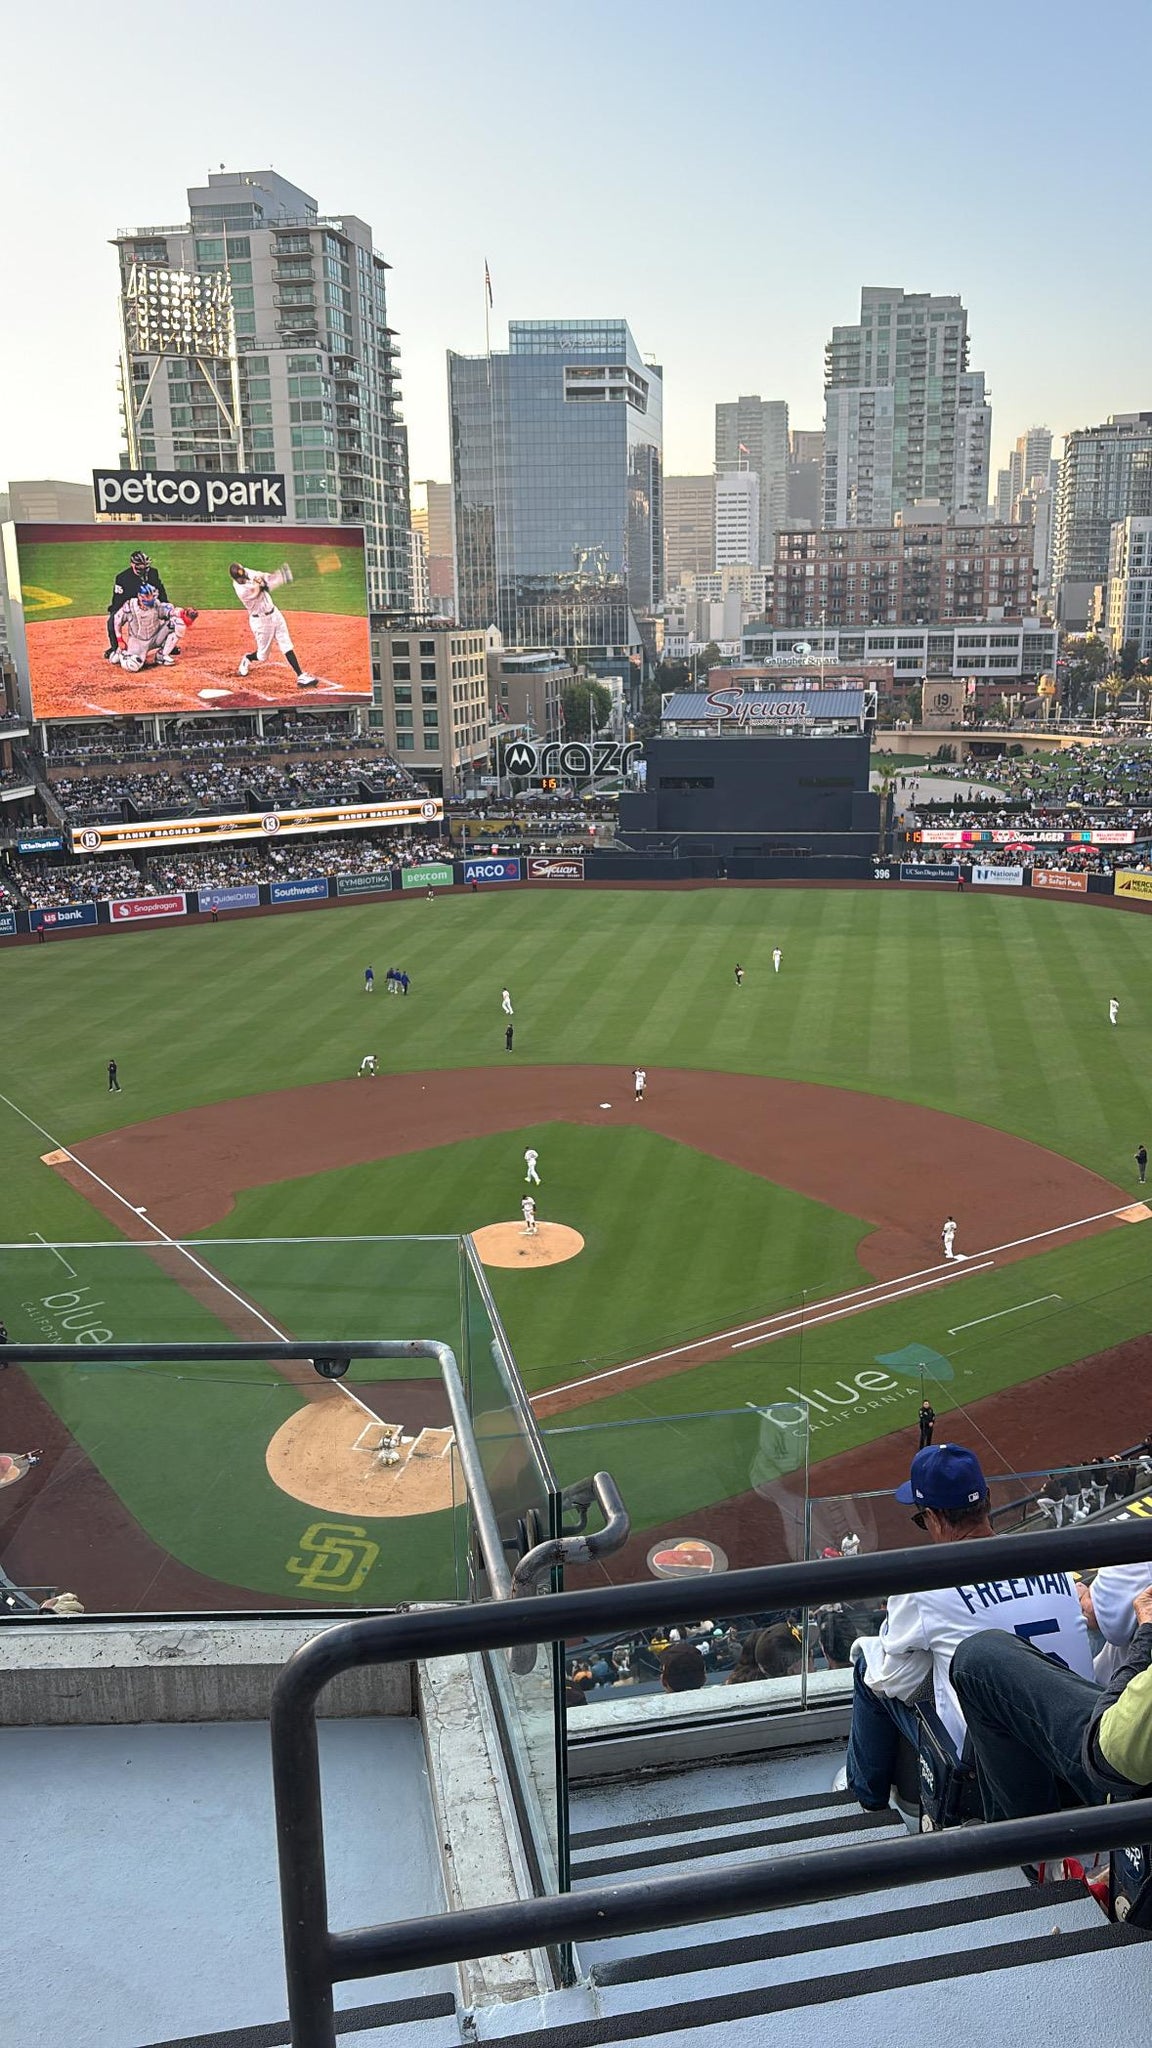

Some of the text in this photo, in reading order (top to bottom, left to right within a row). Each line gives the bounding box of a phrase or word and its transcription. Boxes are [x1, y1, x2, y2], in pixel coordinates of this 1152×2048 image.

[98, 473, 283, 512] petco park
[763, 655, 839, 666] Gallagher Square
[704, 687, 811, 726] Sycuan
[938, 694, 949, 706] 19
[541, 741, 644, 777] razr
[117, 827, 201, 840] MANNY MACHADO
[466, 864, 504, 878] ARCO
[532, 860, 578, 878] Sycuan
[874, 869, 890, 879] 396
[990, 868, 1020, 878] National
[274, 884, 318, 898] Southwest
[57, 910, 83, 921] bank
[134, 902, 178, 913] Snapdragon
[21, 1301, 63, 1344] CALIFORN
[40, 1286, 113, 1345] blue
[745, 1370, 899, 1429] blue
[792, 1387, 919, 1438] CALIFORNIA
[955, 1572, 1072, 1615] FREEMAN
